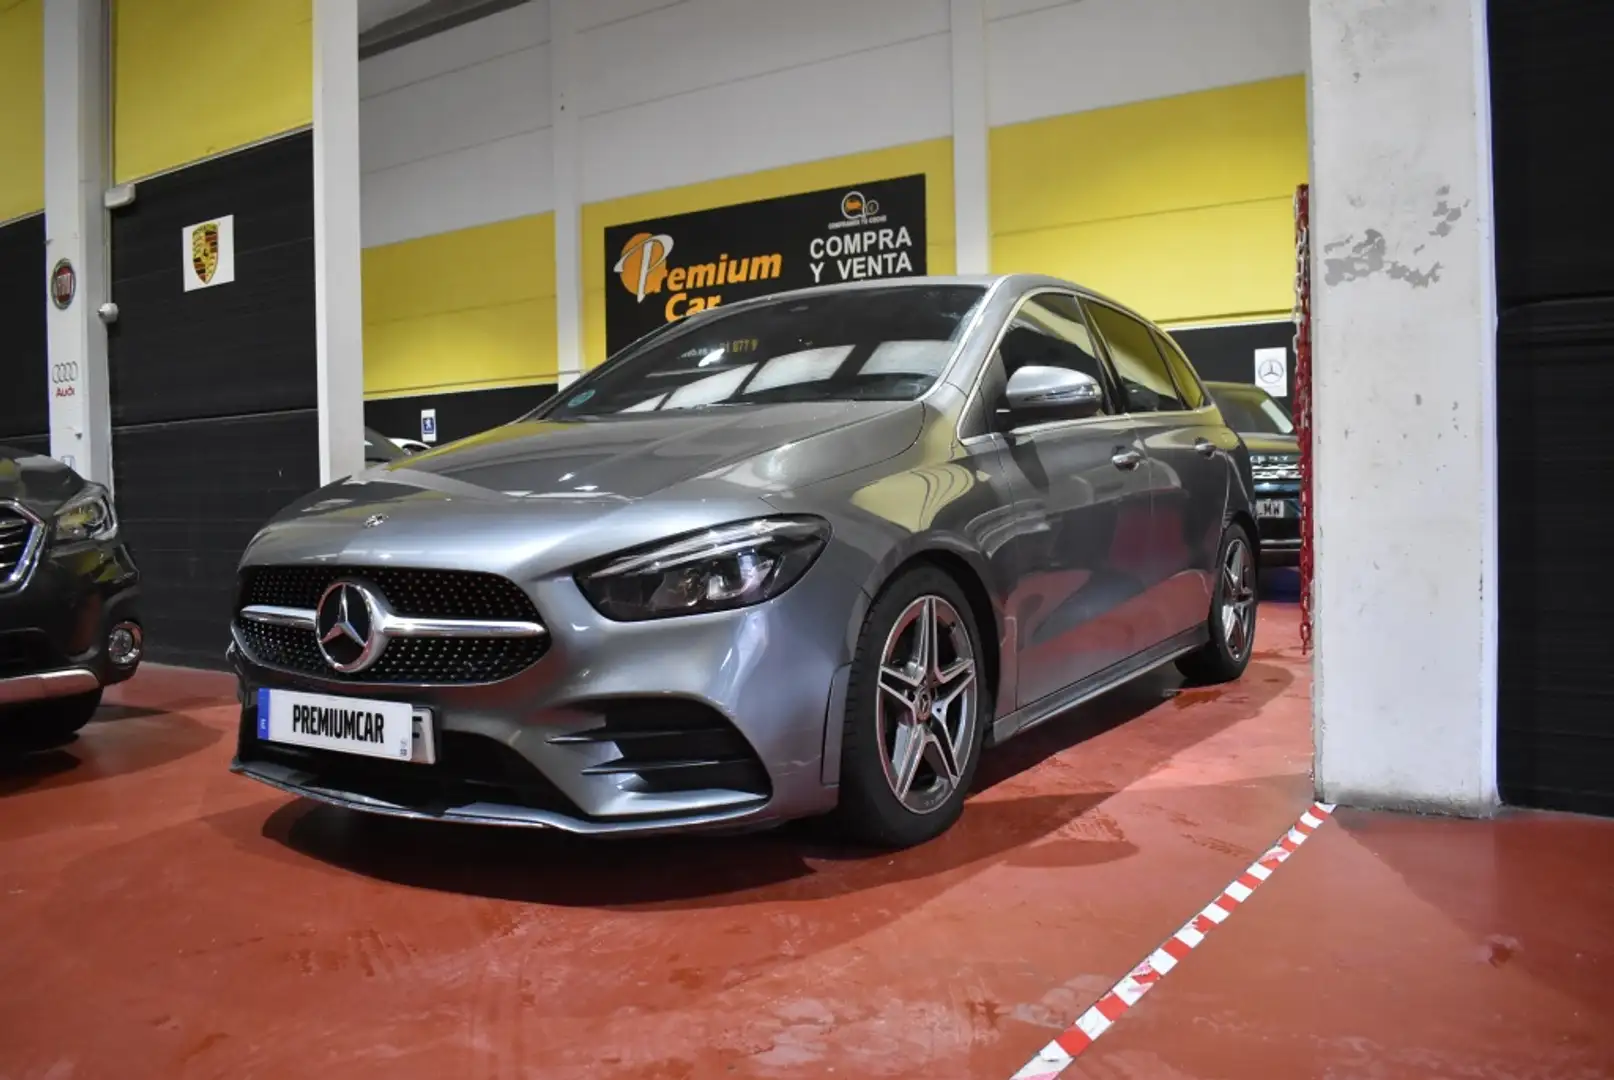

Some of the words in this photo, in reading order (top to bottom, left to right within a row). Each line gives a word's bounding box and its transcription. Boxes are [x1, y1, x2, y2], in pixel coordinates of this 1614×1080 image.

[810, 226, 912, 259] COMPRA
[613, 234, 783, 303] Premium
[810, 262, 825, 283] Y
[837, 251, 913, 280] VENTA
[665, 293, 722, 323] Car
[56, 386, 75, 398] Audi
[292, 703, 385, 744] PREMIUMCAR
